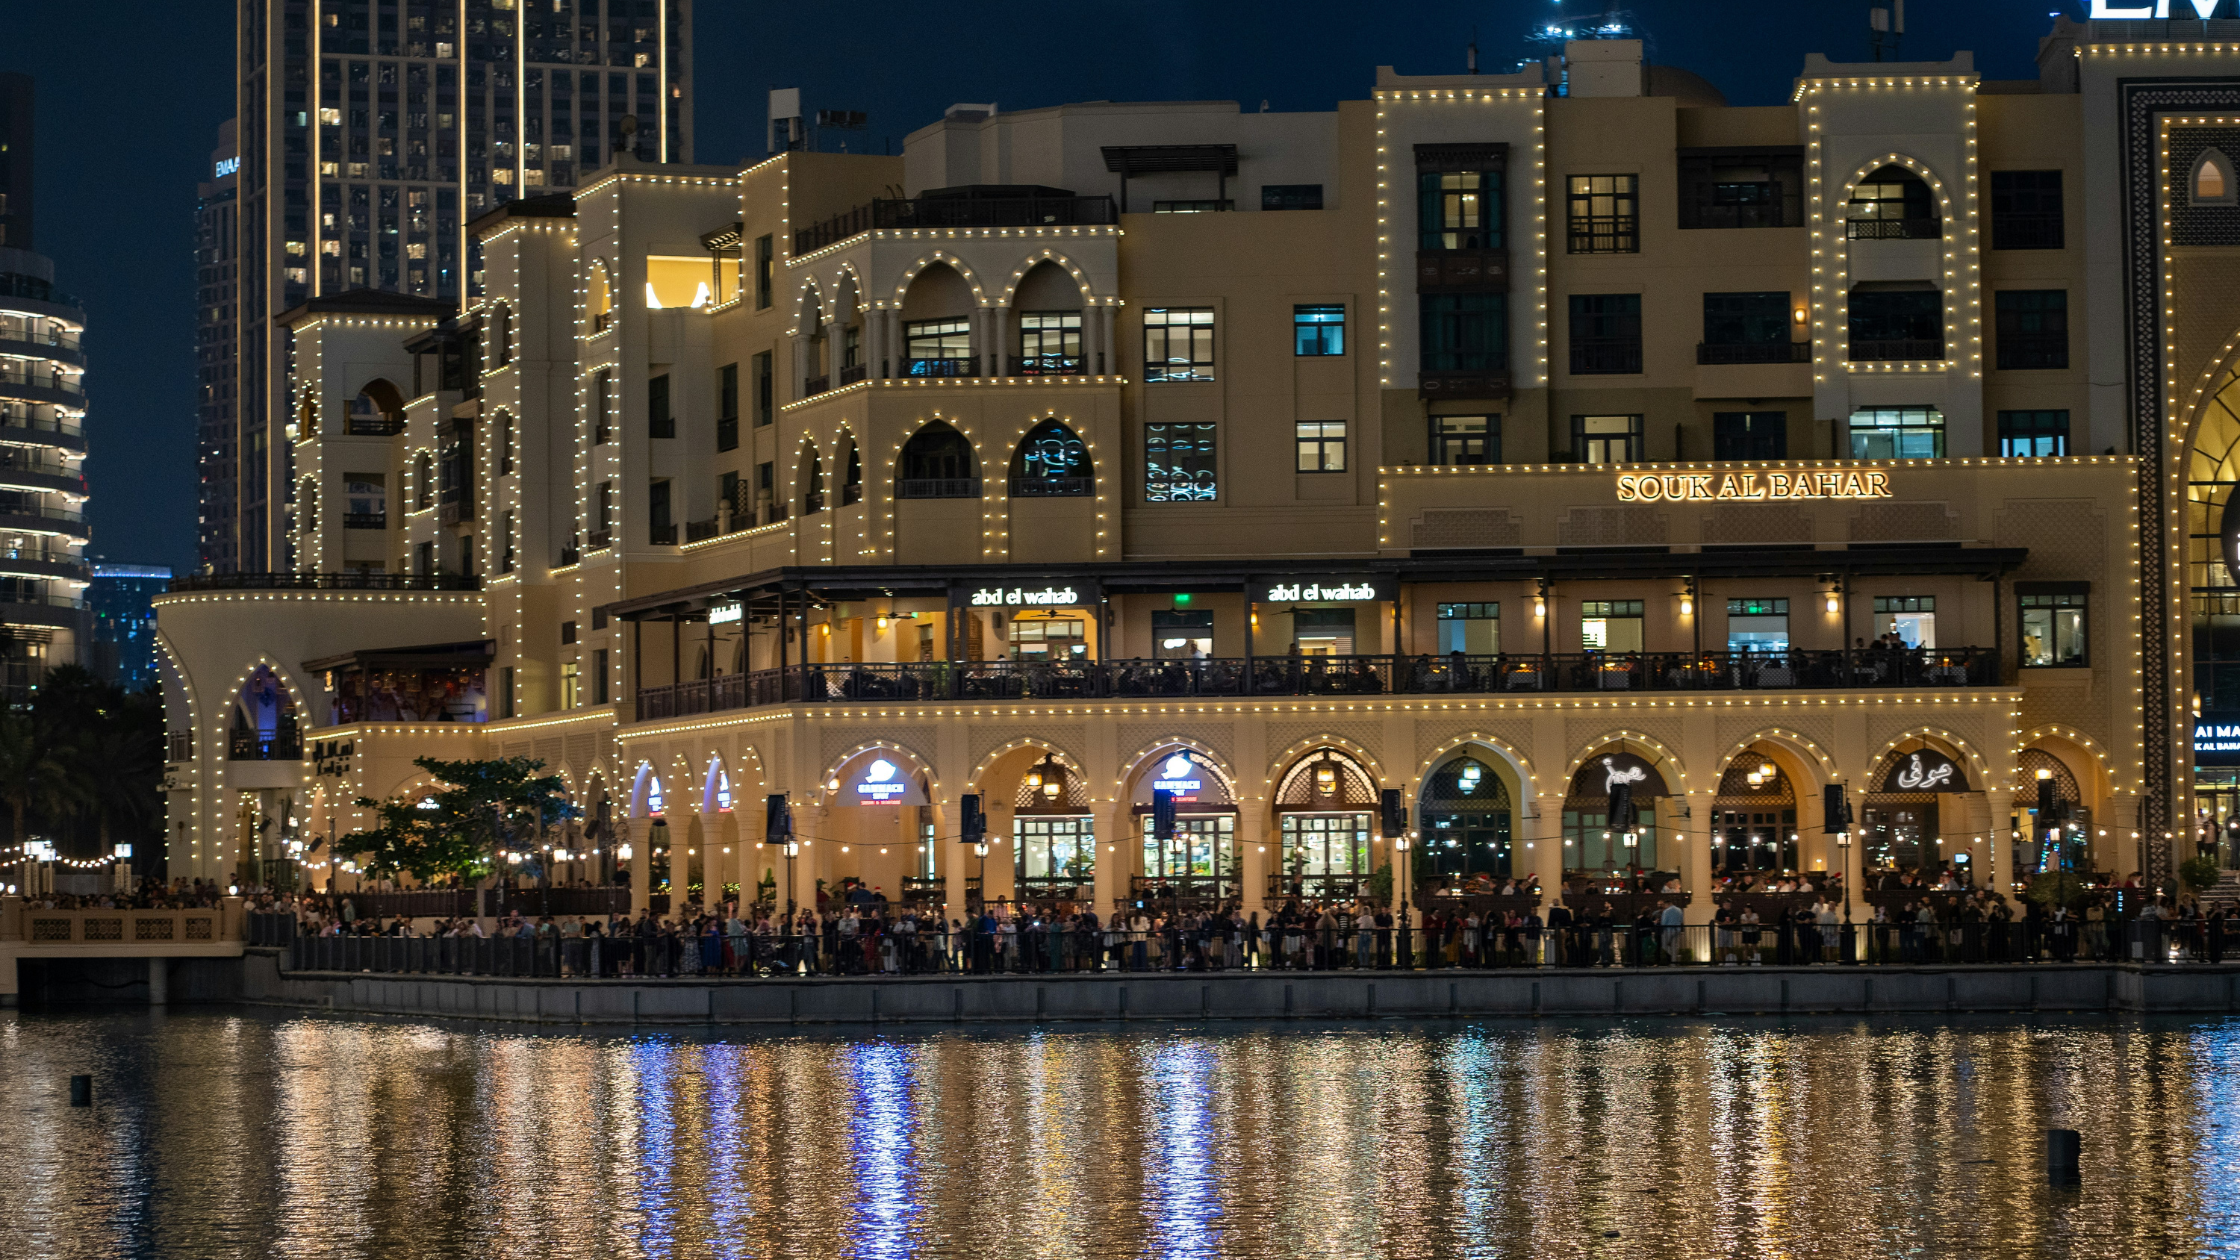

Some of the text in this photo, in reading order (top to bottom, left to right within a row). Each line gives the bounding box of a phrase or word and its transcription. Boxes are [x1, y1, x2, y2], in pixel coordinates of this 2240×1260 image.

[1617, 472, 1893, 500] SOUK AL BAHAR
[971, 587, 1078, 605] abd el wahab
[1268, 583, 1375, 601] abd el wahab
